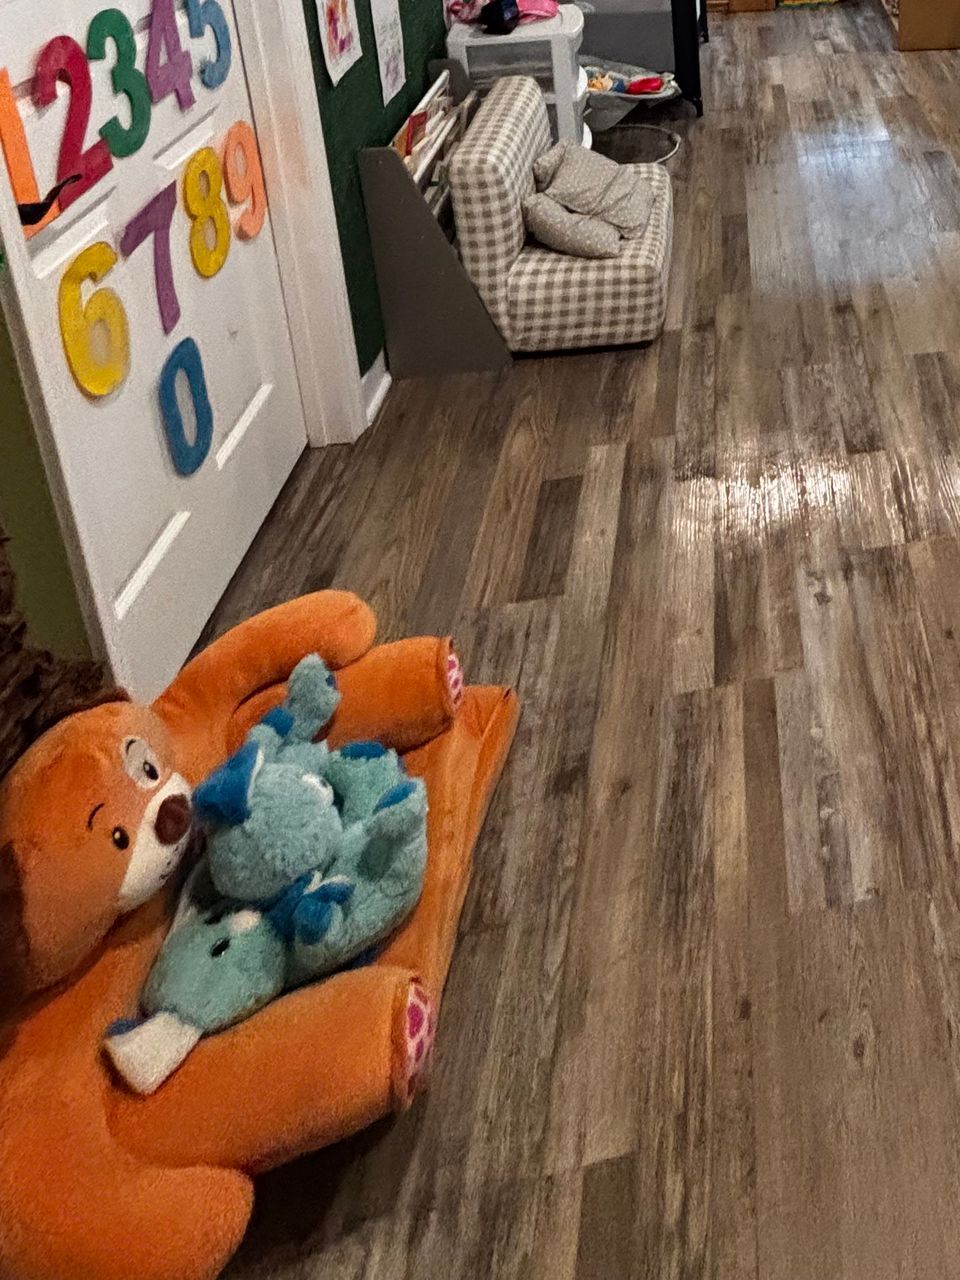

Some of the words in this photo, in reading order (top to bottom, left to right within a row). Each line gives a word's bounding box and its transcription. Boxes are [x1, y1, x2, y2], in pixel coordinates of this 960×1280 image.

[31, 35, 114, 213] 2
[86, 7, 152, 159] 3
[57, 240, 131, 399] 6
[119, 179, 181, 336] 7
[182, 145, 231, 279] 8
[222, 119, 267, 241] 9
[158, 336, 214, 478] 0
